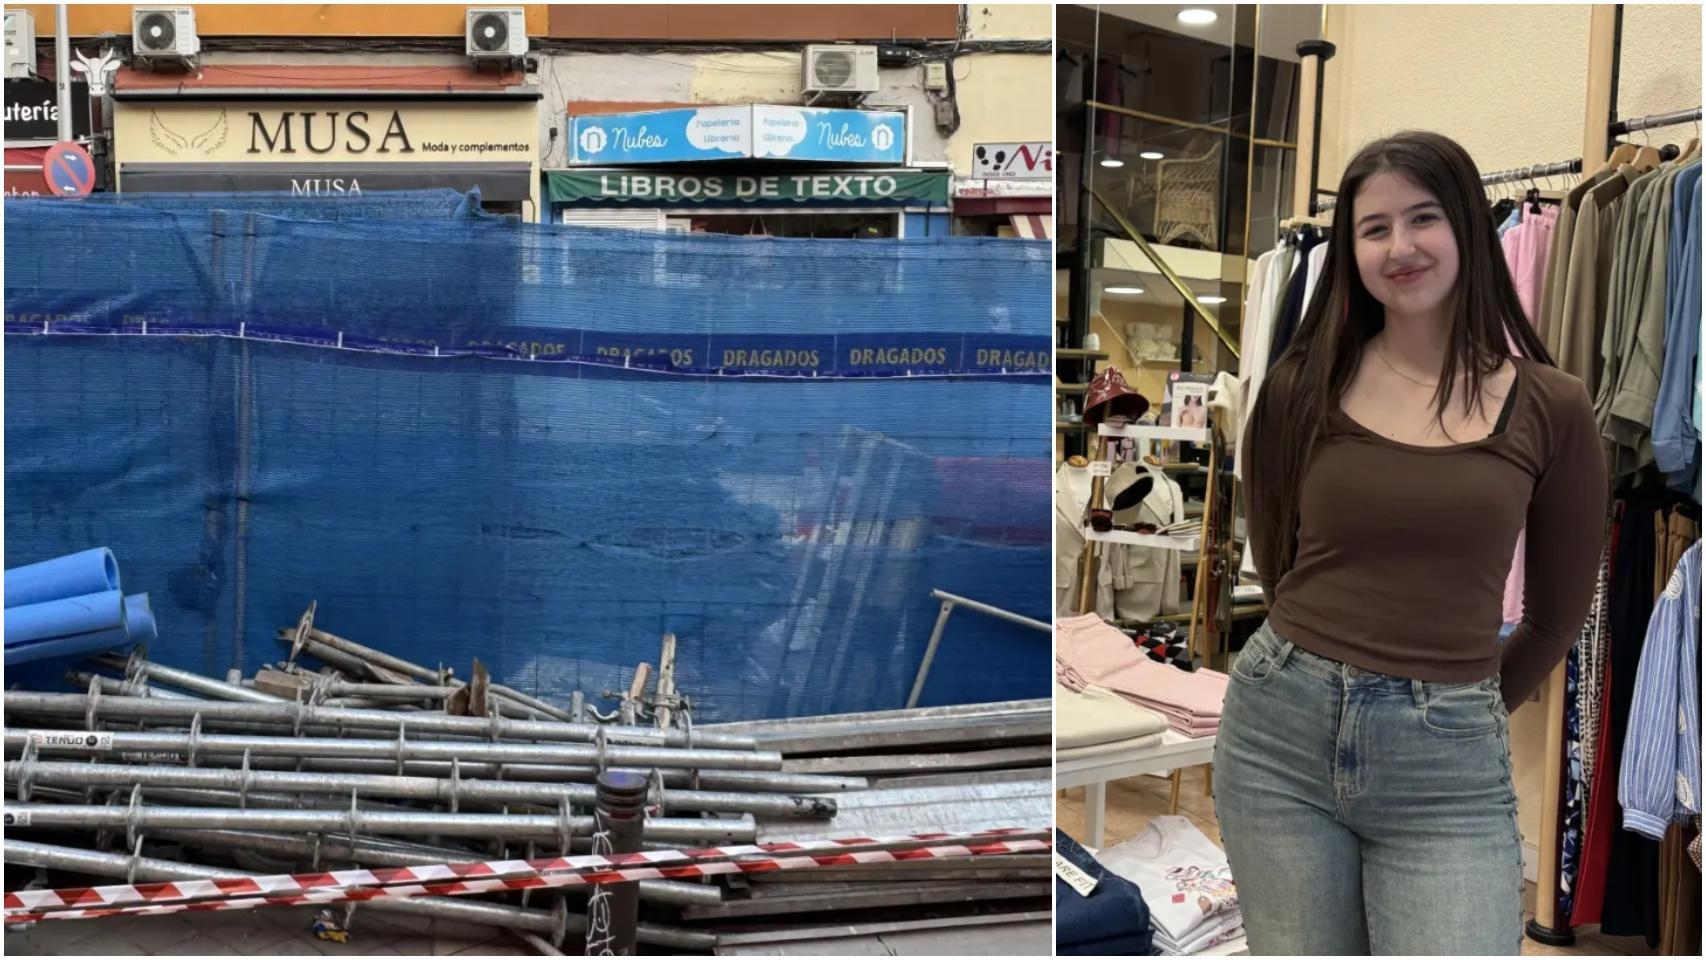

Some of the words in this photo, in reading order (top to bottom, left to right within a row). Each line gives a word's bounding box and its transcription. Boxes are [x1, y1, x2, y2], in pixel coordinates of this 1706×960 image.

[246, 109, 415, 154] MUSA
[612, 125, 668, 152] Nubes
[817, 122, 867, 149] Nubes
[422, 141, 449, 152] Moda
[451, 143, 457, 154] y
[459, 141, 530, 154] complementos
[291, 178, 363, 197] MUSA
[600, 174, 723, 197] LIBROS
[736, 175, 779, 197] DE
[790, 174, 897, 197] TEXTO
[723, 349, 820, 367] DRAGADOS
[849, 347, 947, 366] DRAGADOS
[1073, 877, 1094, 890] FIT
